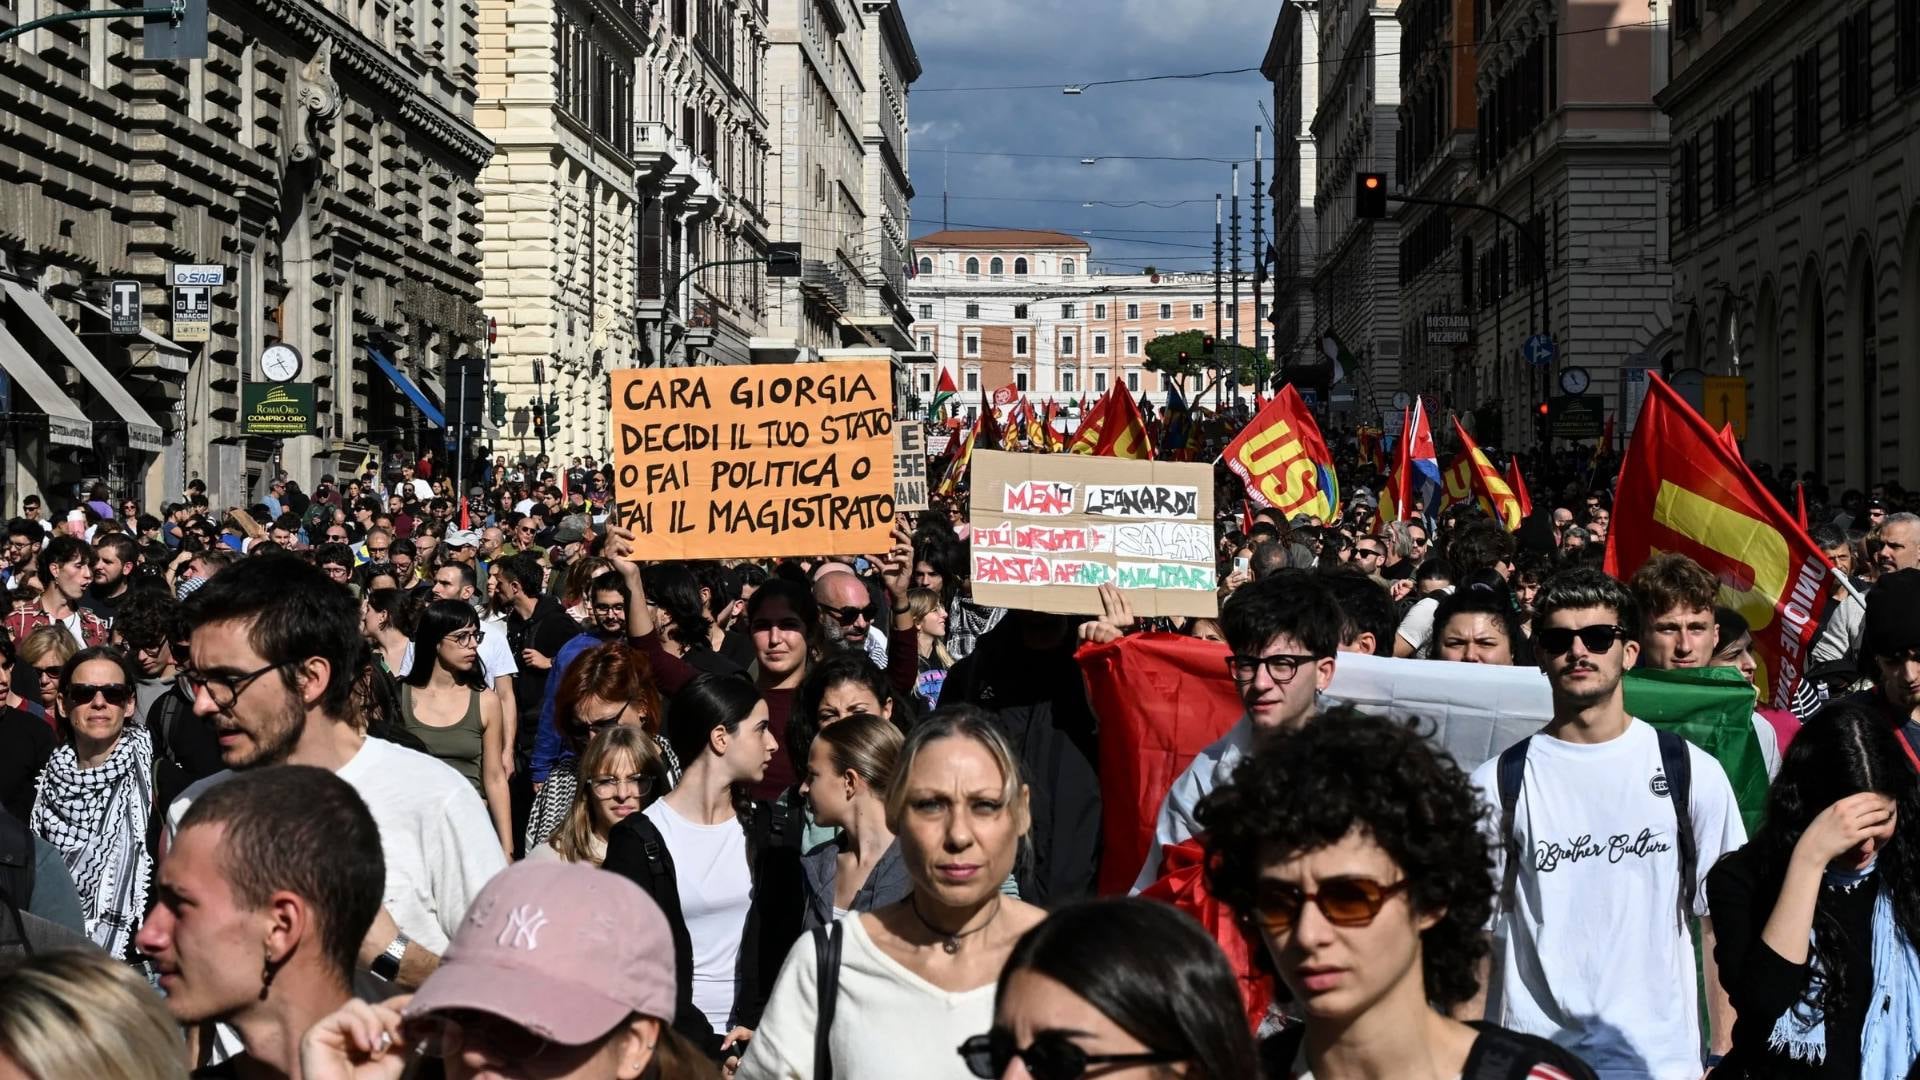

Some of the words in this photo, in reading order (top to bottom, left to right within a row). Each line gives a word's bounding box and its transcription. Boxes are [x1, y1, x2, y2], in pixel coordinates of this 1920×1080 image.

[115, 285, 136, 316] T
[179, 288, 204, 310] T
[1427, 315, 1470, 328] HOSTARIA
[1428, 331, 1468, 343] PIZZERIA
[623, 376, 712, 411] CARA
[730, 373, 877, 409] GIORGIA
[621, 423, 718, 455] DECIDI
[730, 424, 752, 451] IL
[758, 420, 809, 448] TUO
[821, 407, 892, 445] STATO
[620, 464, 638, 488] O
[646, 461, 689, 496] FAI
[711, 453, 839, 492] POLITICA
[851, 456, 871, 481] O
[1229, 457, 1252, 487] UNIONE
[617, 498, 653, 535] FAI
[669, 500, 696, 533] IL
[708, 492, 895, 535] MAGISTRATO
[1007, 483, 1073, 514] MENO
[1084, 485, 1197, 517] LEONARDO
[975, 556, 1050, 584] BASTA
[1535, 834, 1607, 872] Brother
[1608, 828, 1671, 864] Culture
[497, 903, 548, 951] NY
